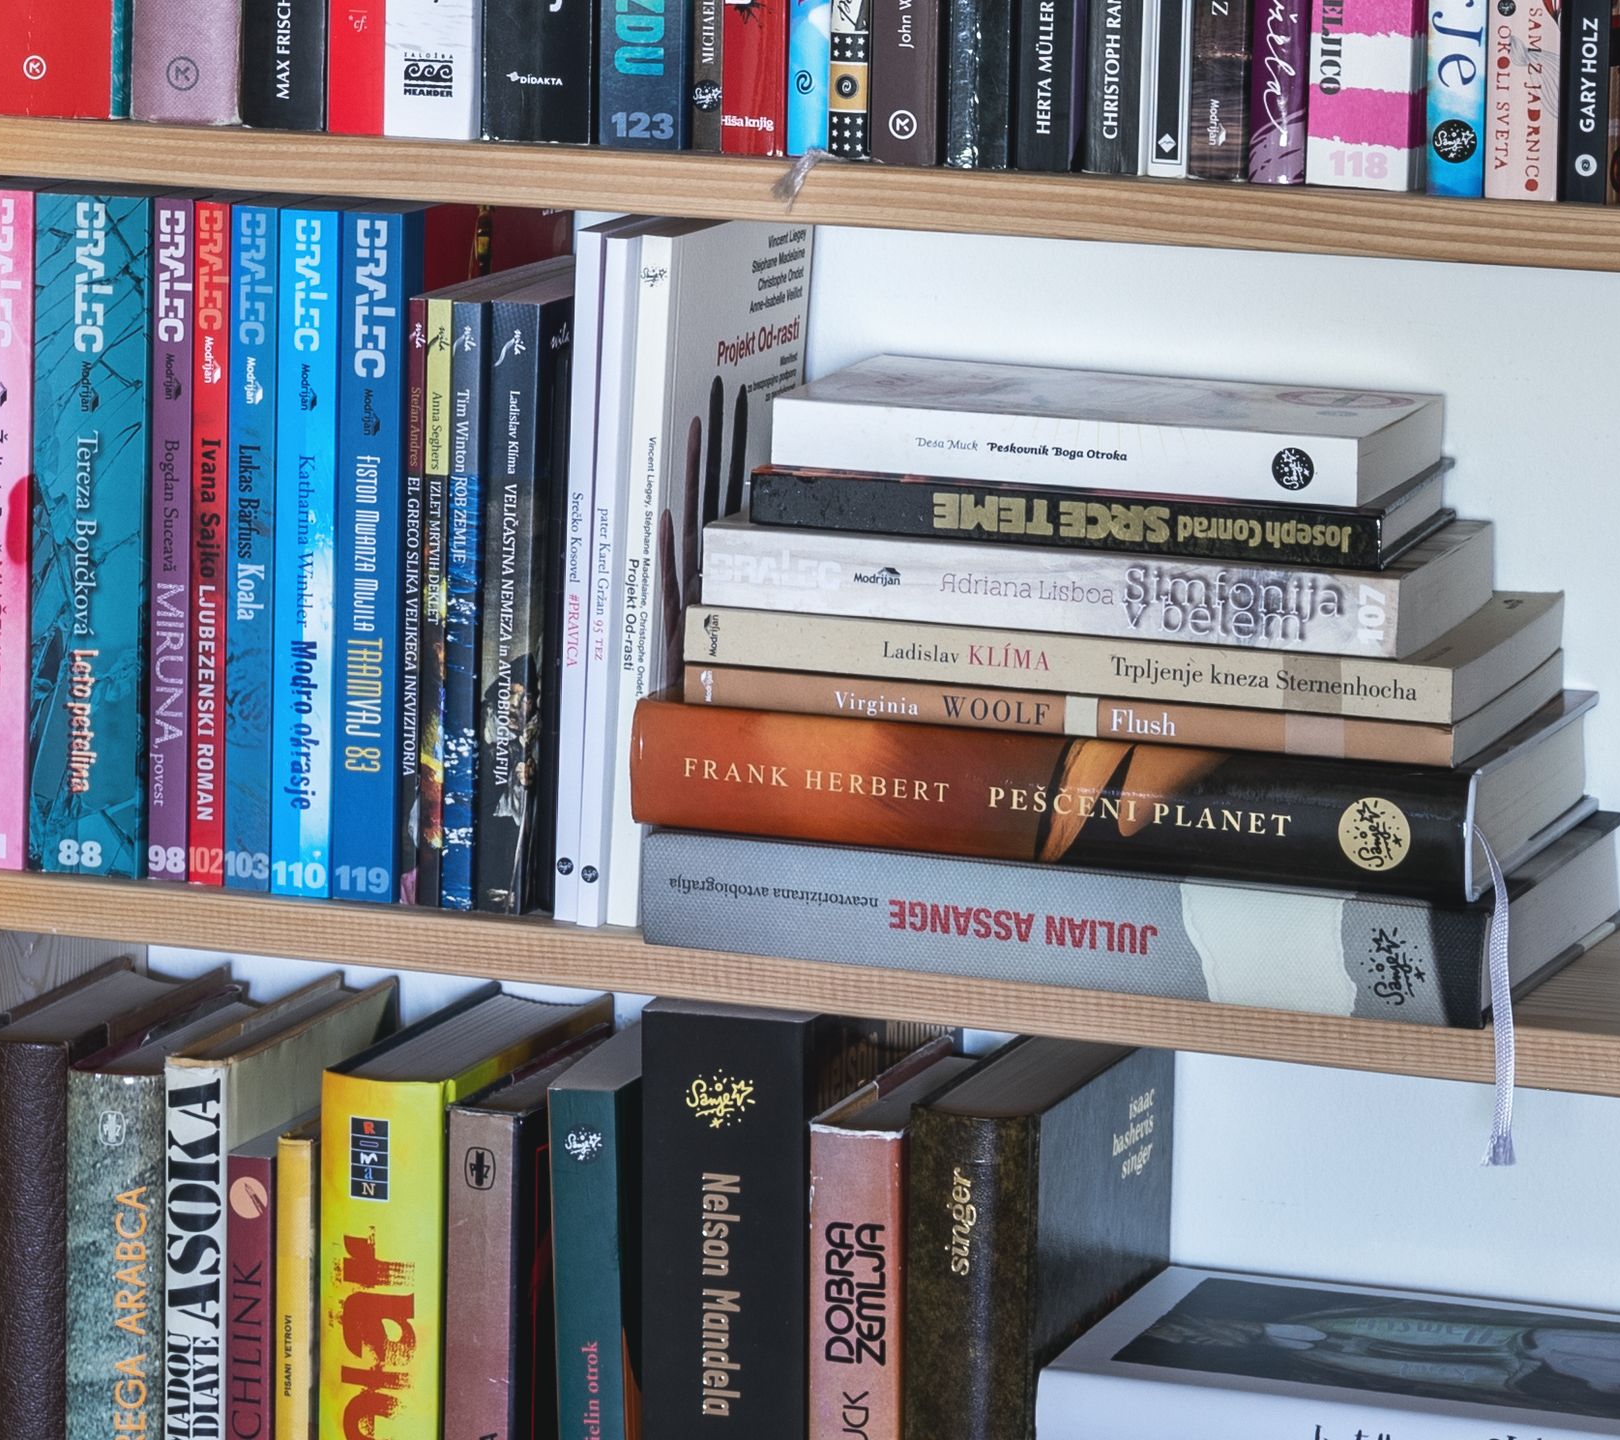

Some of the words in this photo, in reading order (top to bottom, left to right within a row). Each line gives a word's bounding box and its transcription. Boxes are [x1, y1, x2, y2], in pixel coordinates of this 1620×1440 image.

[1579, 17, 1599, 64] HOLZ
[276, 61, 289, 100] MAX
[1579, 69, 1601, 133] GARY
[932, 491, 1047, 537] TEME
[1061, 501, 1169, 545] SRCE
[1175, 513, 1253, 546] Conrad
[1260, 518, 1351, 553] Joseph
[882, 640, 960, 666] Ladislav
[967, 642, 1051, 673] KLÍMA
[833, 690, 919, 718] Virginia
[941, 693, 1051, 727] WOOLF
[1109, 706, 1177, 738] Flush
[684, 757, 789, 790] FRANK
[803, 767, 950, 804] HERBERT
[987, 779, 1139, 822] PEŠČENI
[1152, 802, 1292, 839] PLANET
[58, 839, 102, 868] 88
[272, 862, 326, 889] 110
[888, 897, 1035, 945] ASSANGE
[1044, 916, 1159, 956] JULIAN
[701, 1171, 741, 1277] Nelson
[944, 1167, 977, 1275] singer
[825, 1221, 854, 1364] DOBRA
[856, 1223, 887, 1366] ZEMLJA
[701, 1289, 742, 1417] Mandela
